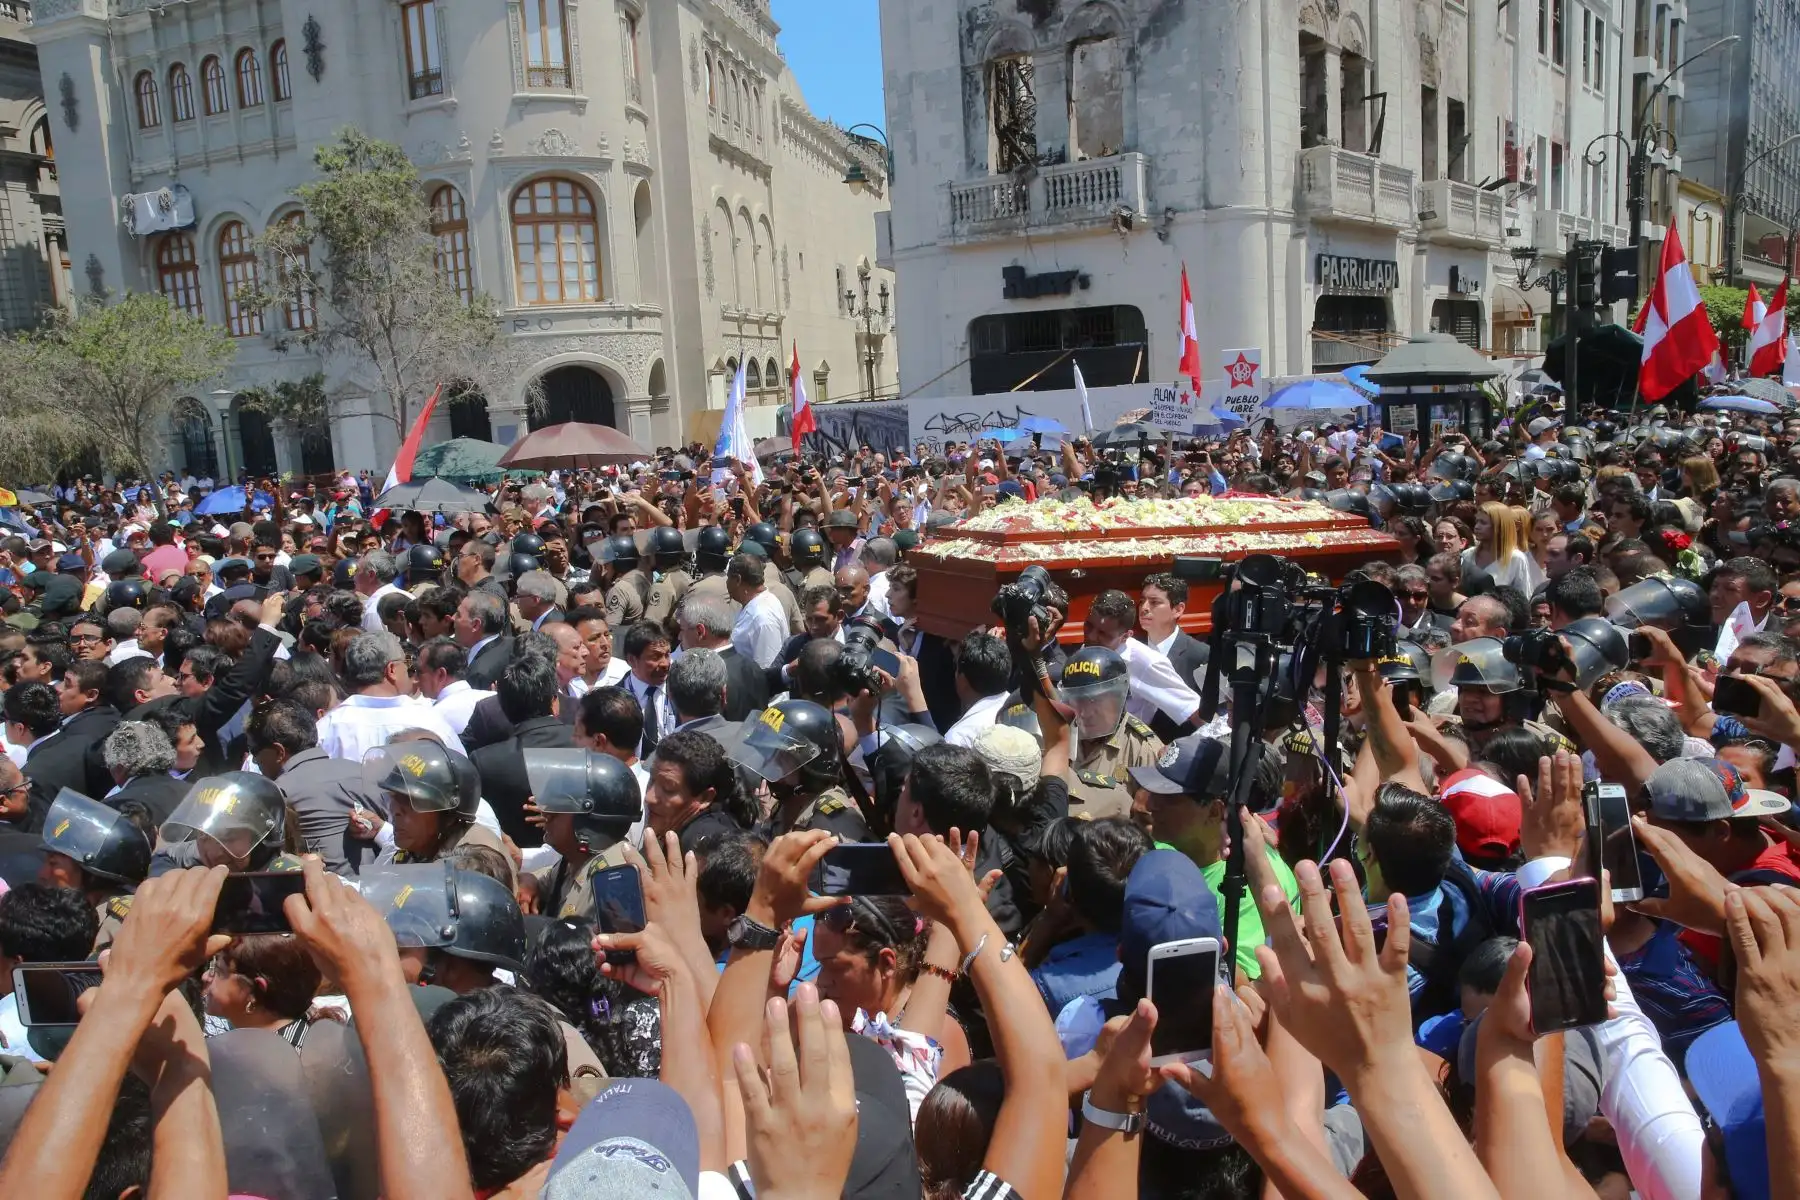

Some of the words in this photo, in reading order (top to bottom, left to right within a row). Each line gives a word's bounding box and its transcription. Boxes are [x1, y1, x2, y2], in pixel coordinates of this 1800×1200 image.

[1153, 387, 1176, 403] ALAN
[1225, 395, 1259, 405] PUEBLO
[1230, 404, 1255, 413] LIBRE
[1064, 660, 1100, 678] POLICIA
[596, 1084, 633, 1103] ITALIA
